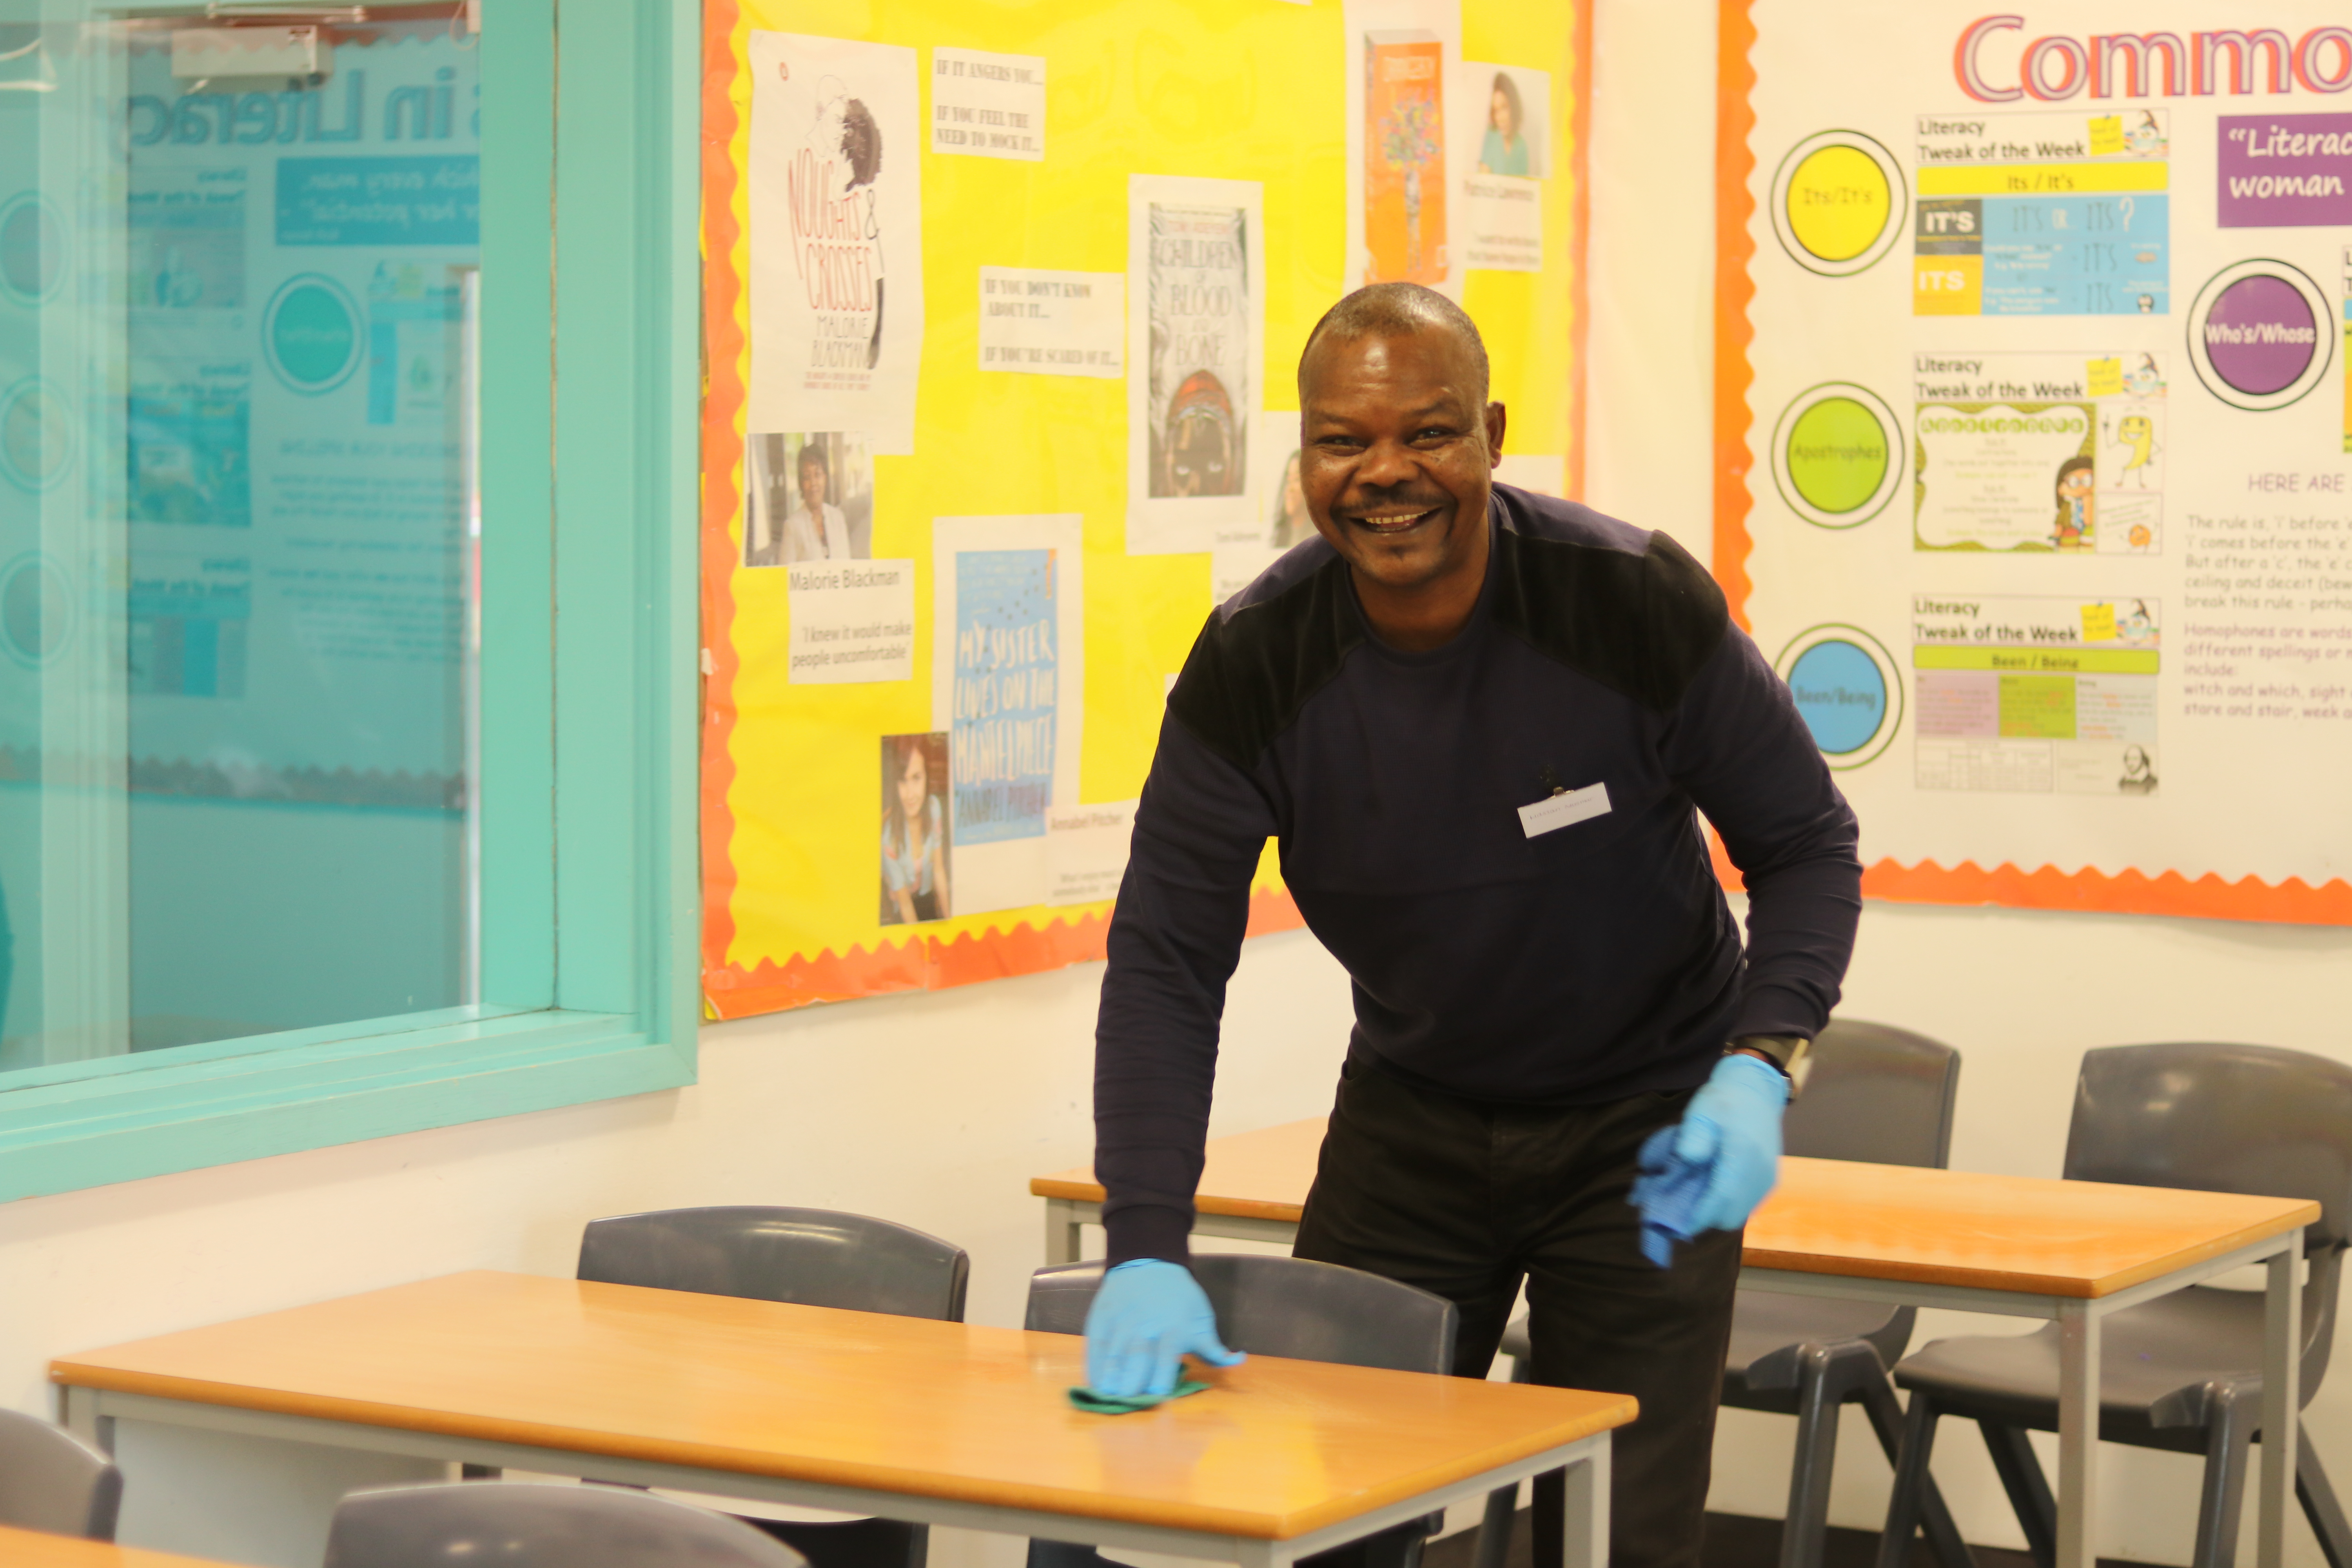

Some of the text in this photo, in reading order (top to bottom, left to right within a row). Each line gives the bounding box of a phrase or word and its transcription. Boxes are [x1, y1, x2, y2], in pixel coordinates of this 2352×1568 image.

[937, 59, 949, 74] IF
[953, 61, 965, 76] IT
[969, 63, 1011, 81] ANGERS
[937, 105, 1029, 128] IF YOU FEEL THE
[1918, 119, 1986, 136] Literacy
[937, 128, 966, 144] NEED
[971, 131, 985, 146] TO
[989, 132, 1018, 149] MOCK
[1918, 140, 2085, 160] Tweak of the Week
[2007, 174, 2029, 190] Its
[2048, 172, 2074, 190] It's
[2229, 174, 2345, 198] woman
[1803, 186, 1873, 206] Its/It's
[1925, 211, 1976, 234] IT'S
[1159, 238, 1238, 269] CHILDREN
[806, 243, 873, 312] CROSSES
[985, 279, 996, 294] IF
[1001, 279, 1022, 295] YOU
[1918, 270, 1965, 291] ITS
[1170, 284, 1231, 316] BLOOD
[2205, 322, 2316, 345] Who's/Whose
[985, 347, 997, 361] IF
[1176, 334, 1226, 366] BONE
[1916, 358, 1983, 376] Literacy
[1916, 381, 2084, 398] Tweak of the Week
[2248, 473, 2345, 493] HERE ARE
[2186, 514, 2214, 529] The
[2219, 515, 2247, 529] rule
[2290, 515, 2339, 530] before
[2200, 536, 2245, 550] comes
[2250, 535, 2301, 550] before
[2307, 537, 2331, 550] the
[2185, 554, 2210, 568] But
[2215, 556, 2255, 569] after
[2259, 559, 2268, 569] a
[2298, 557, 2321, 570] the
[790, 568, 900, 591] Malorie Blackman
[2185, 574, 2230, 592] ceiling
[2236, 575, 2261, 589] and
[2267, 576, 2313, 589] deceit
[1915, 600, 1980, 618] Literacy
[2185, 595, 2226, 608] break
[2232, 596, 2259, 609] this
[2265, 595, 2294, 609] rule
[810, 626, 840, 642] knew
[852, 621, 881, 639] would
[883, 619, 912, 636] make
[1915, 623, 2078, 642] Tweak of the Week
[2184, 622, 2275, 641] Homophones
[2280, 627, 2304, 638] are
[959, 619, 1055, 670] MY SISTER
[2184, 642, 2321, 663] different spellings
[791, 649, 831, 671] people
[1992, 653, 2027, 668] Been
[2041, 655, 2081, 671] Being
[955, 667, 1056, 720] LIVES ON THE
[2184, 682, 2223, 696] witch
[2227, 682, 2253, 697] and
[2310, 685, 2345, 702] sight
[2184, 704, 2222, 716] stare
[2227, 704, 2252, 716] and
[2303, 706, 2339, 718] week
[955, 712, 1054, 787] MANTELPIECE
